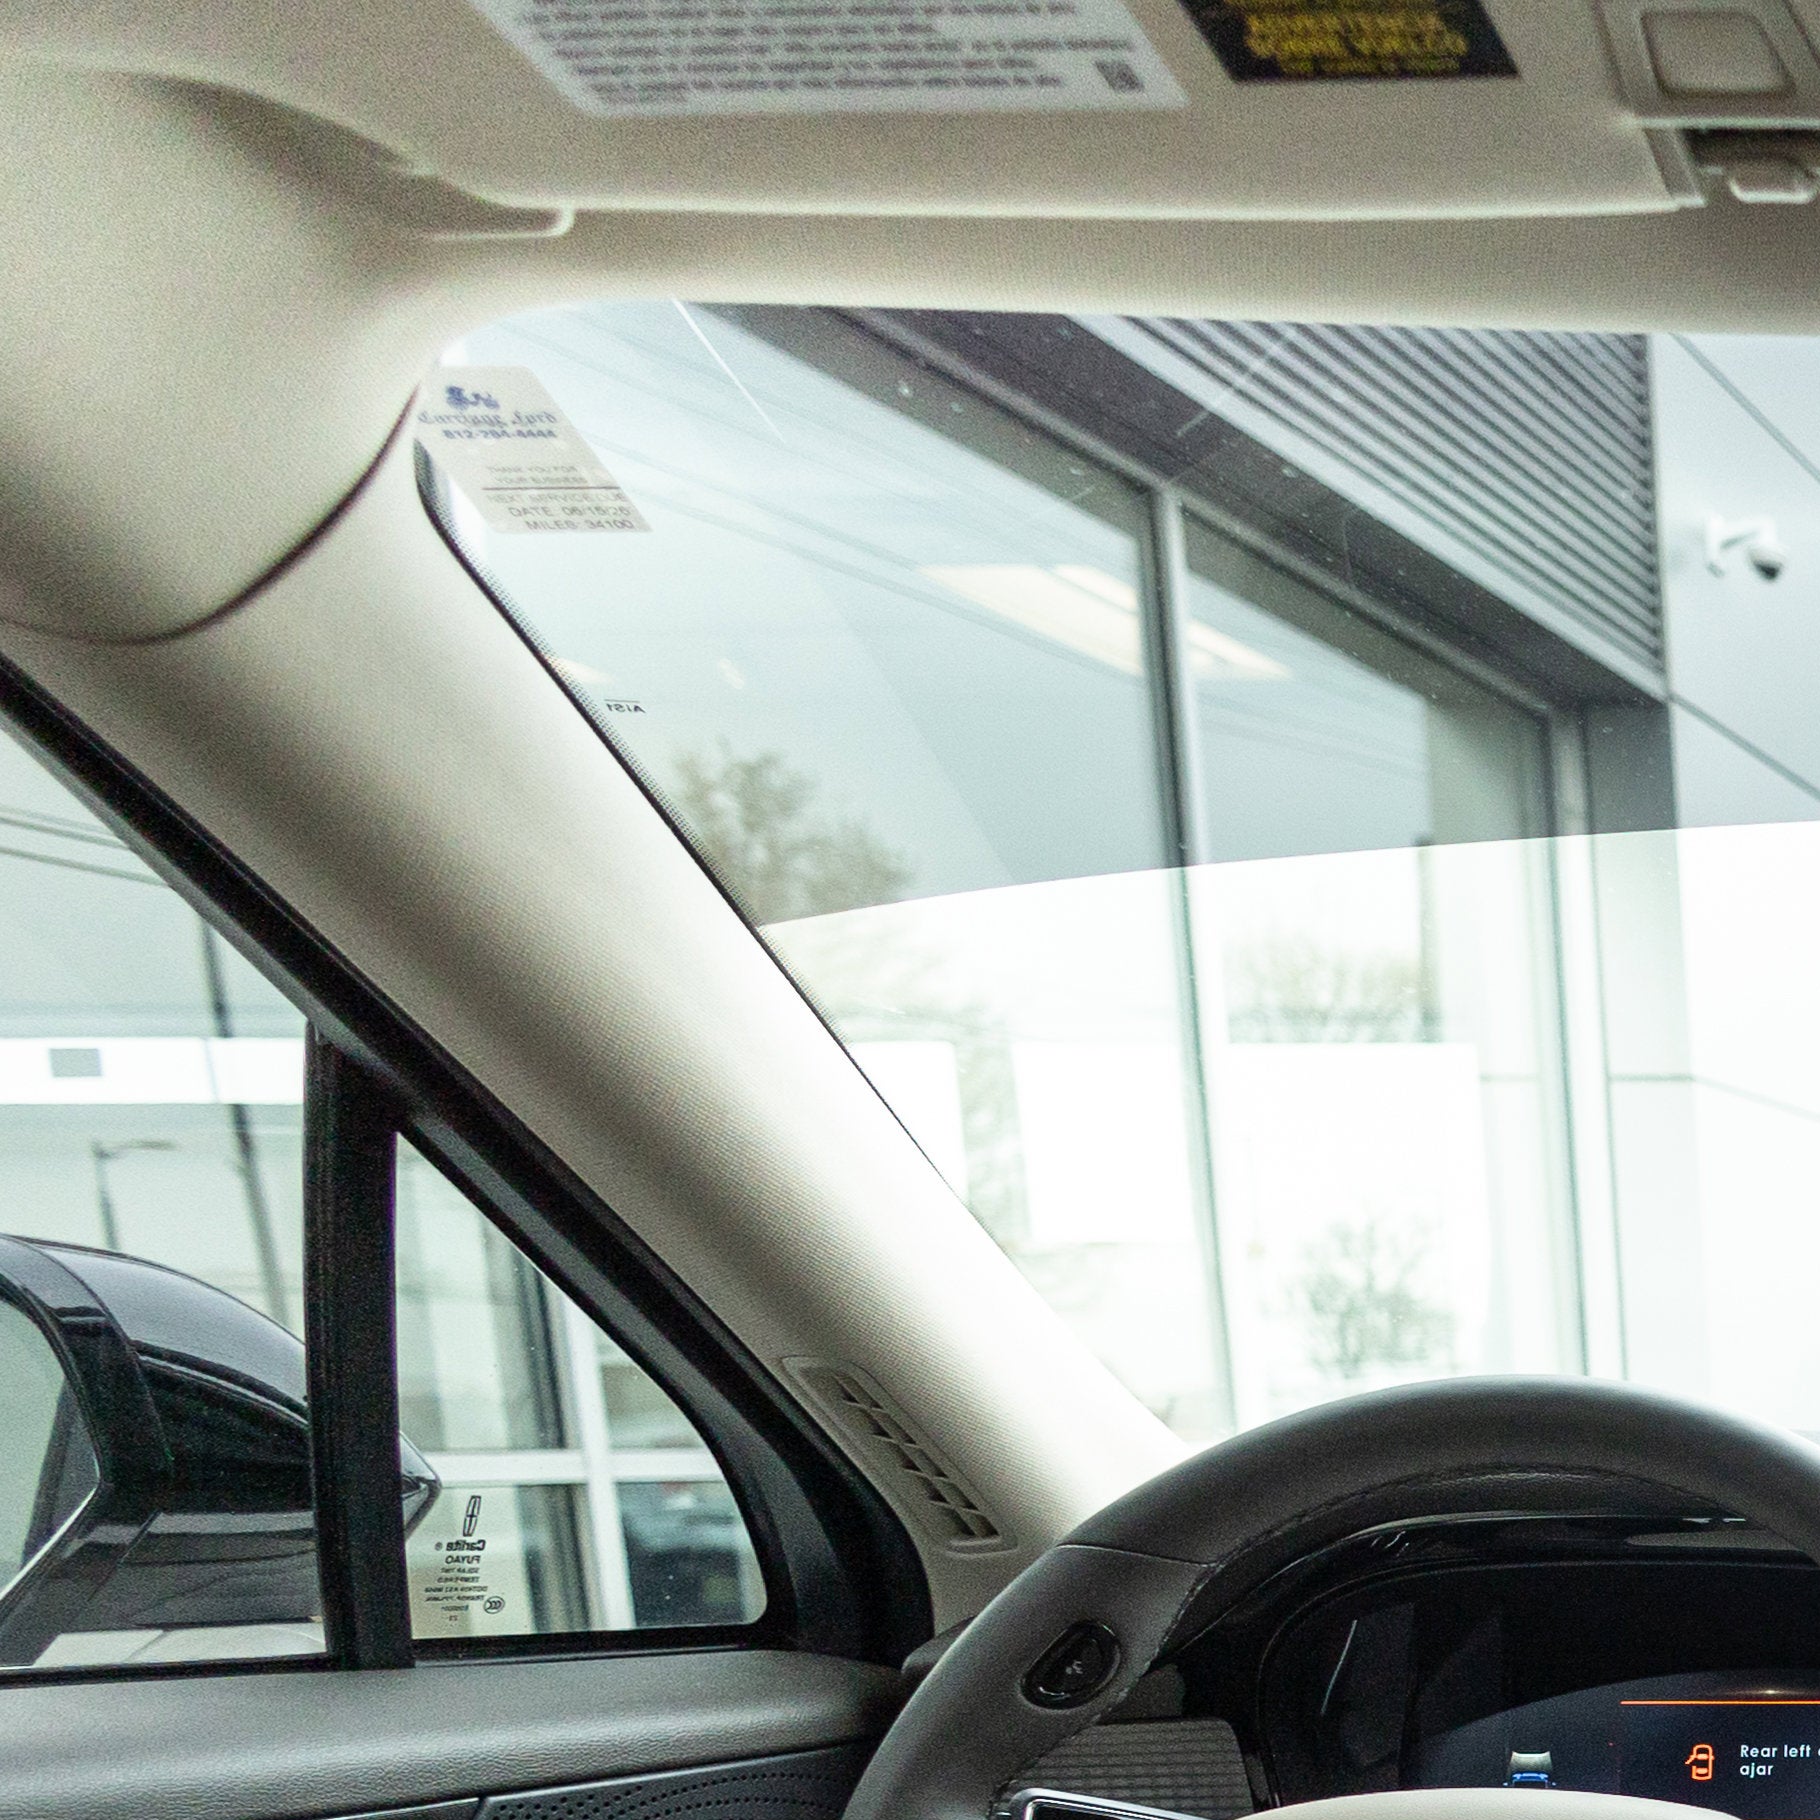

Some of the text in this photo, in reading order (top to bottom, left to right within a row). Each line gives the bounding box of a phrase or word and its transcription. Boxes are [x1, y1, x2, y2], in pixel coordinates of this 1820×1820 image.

[1740, 1745, 1777, 1758] Rear
[1783, 1744, 1811, 1758] left
[1739, 1762, 1774, 1778] ajar
